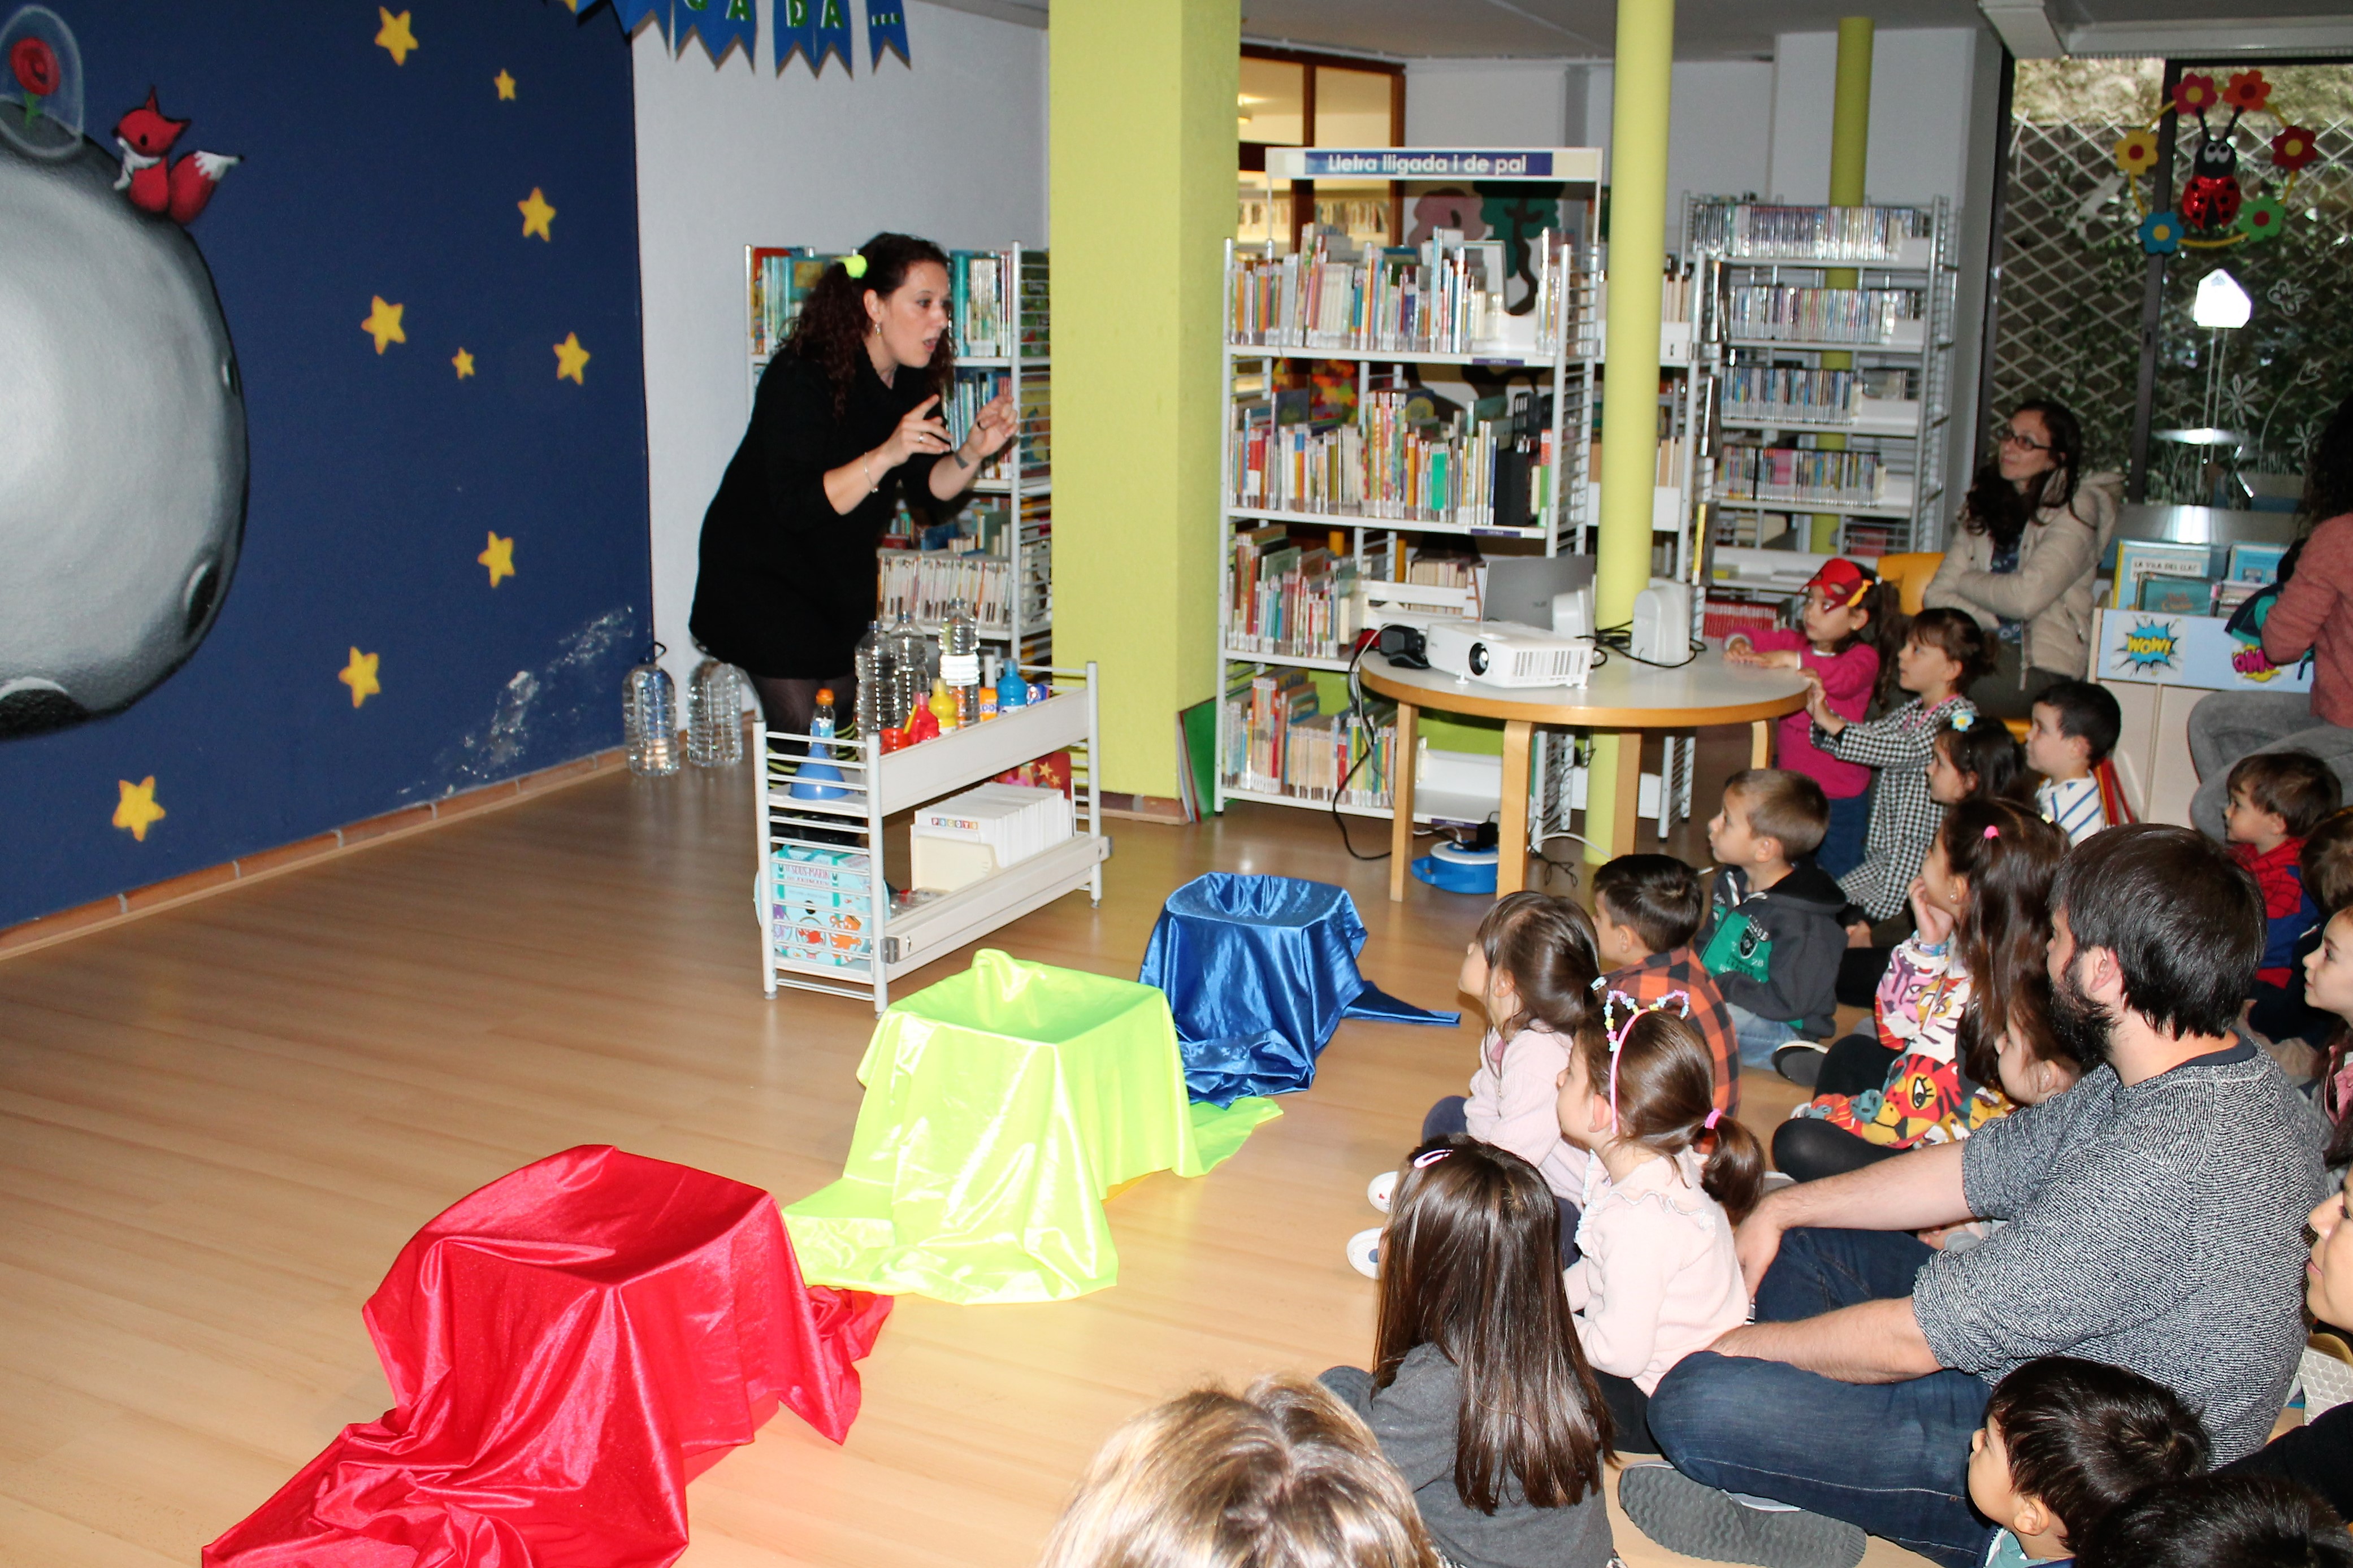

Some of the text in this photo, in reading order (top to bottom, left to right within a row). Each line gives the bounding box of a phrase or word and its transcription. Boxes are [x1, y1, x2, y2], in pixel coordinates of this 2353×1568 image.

[1328, 154, 1527, 175] Lletra lligada i de pal
[2127, 636, 2173, 655] WOW!
[2233, 648, 2276, 673] OM
